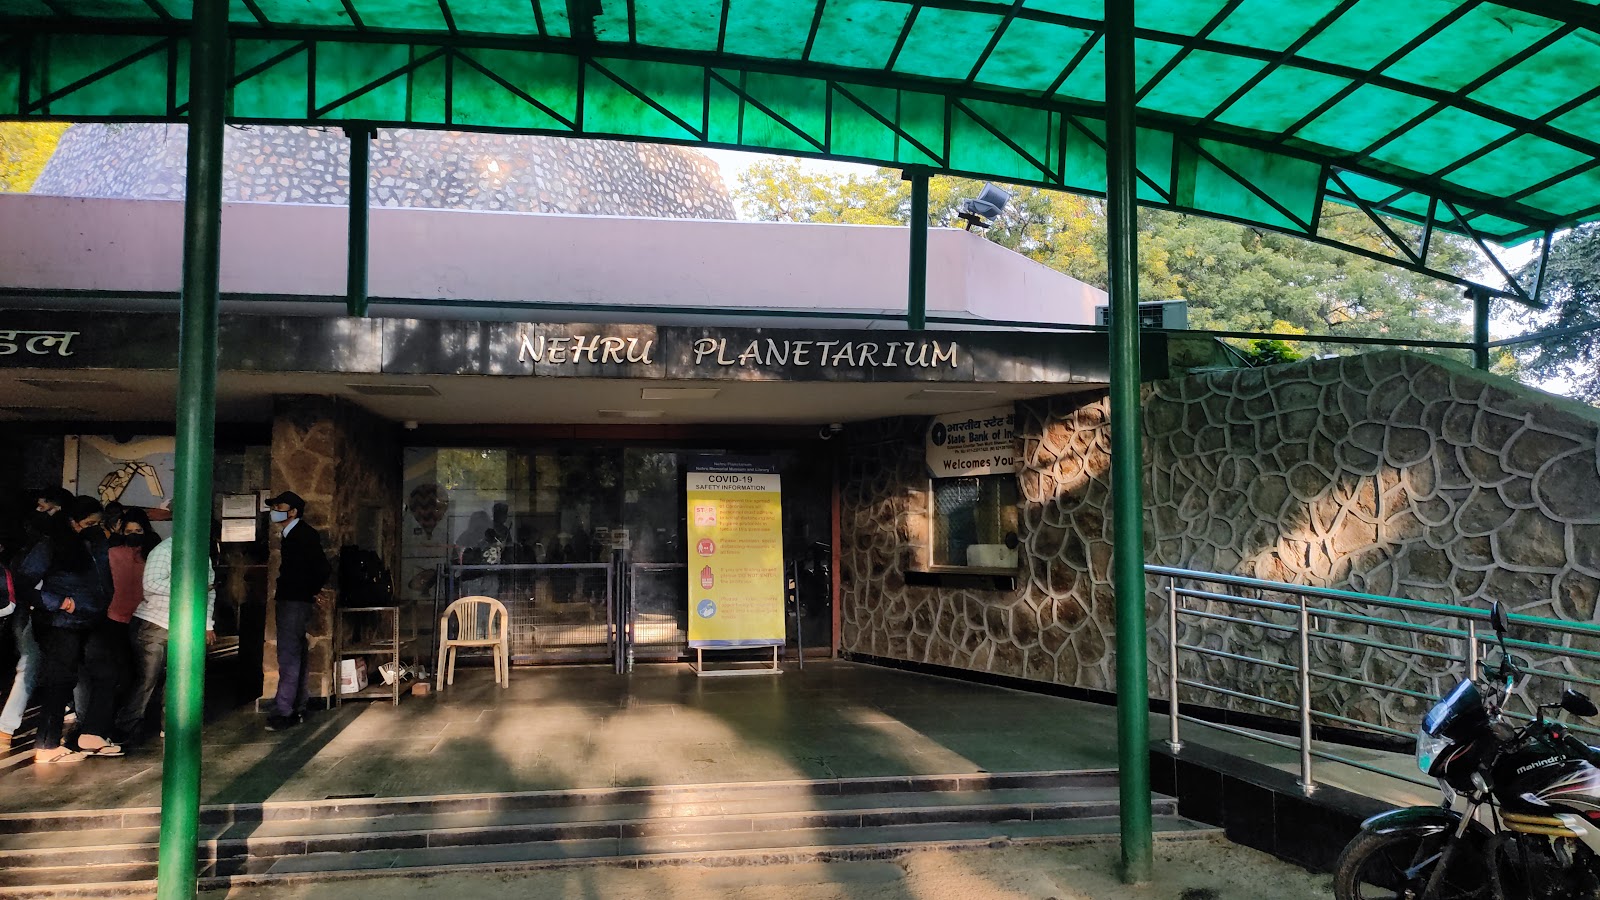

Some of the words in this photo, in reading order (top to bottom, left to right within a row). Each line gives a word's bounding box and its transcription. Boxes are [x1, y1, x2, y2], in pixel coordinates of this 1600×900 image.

[518, 334, 654, 364] NEHRU
[694, 338, 958, 368] PLANETARIUM
[947, 418, 982, 432] भारतीय
[983, 416, 1004, 428] स्टेट
[947, 434, 966, 444] State
[969, 431, 988, 442] Bank
[992, 430, 1000, 440] of
[943, 458, 991, 470] Welcomes
[994, 456, 1014, 467] You
